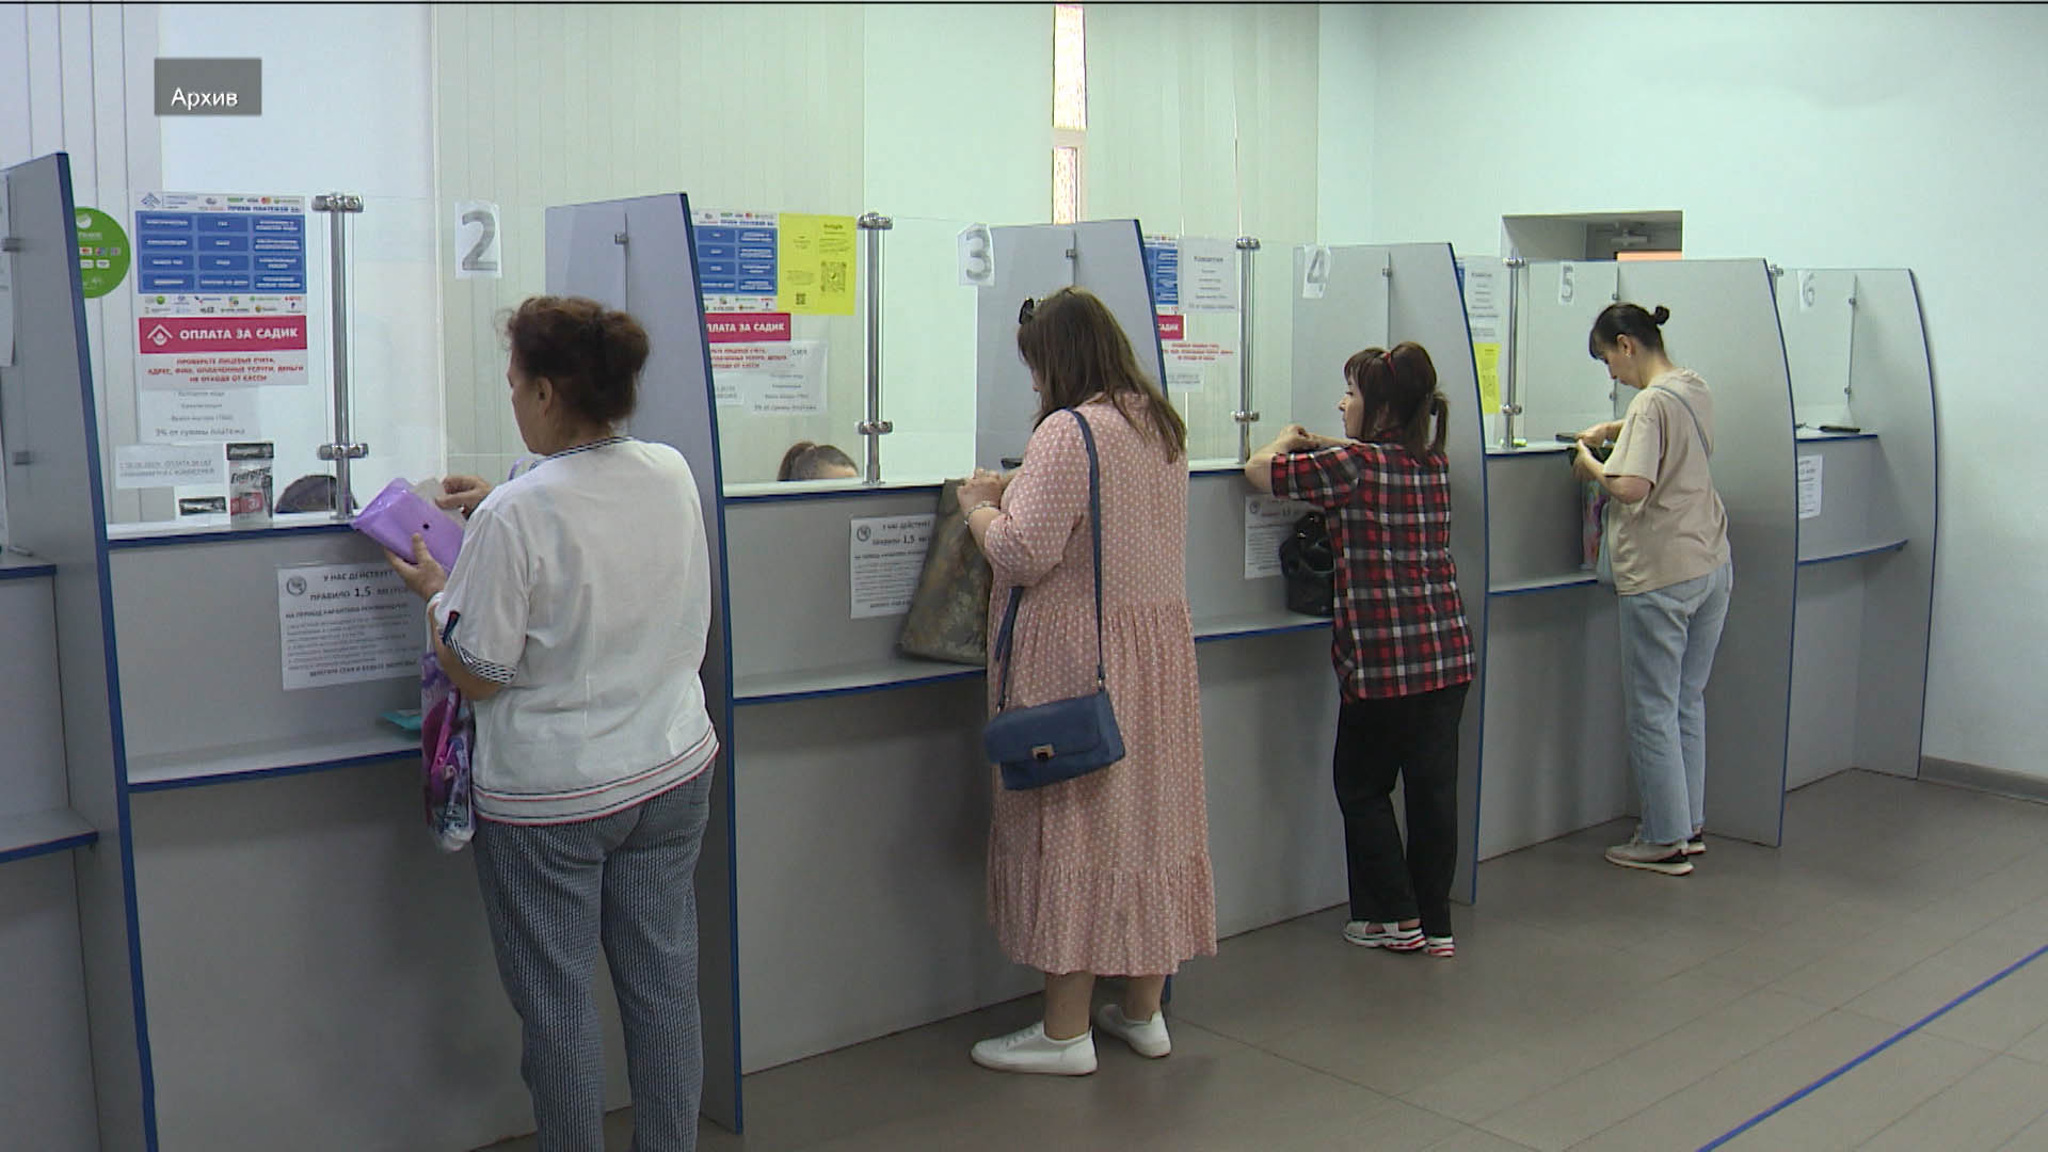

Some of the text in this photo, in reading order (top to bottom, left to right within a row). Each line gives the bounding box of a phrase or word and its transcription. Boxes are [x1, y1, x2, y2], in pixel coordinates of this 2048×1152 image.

[462, 210, 497, 271] 2
[966, 229, 991, 281] 3
[1307, 249, 1327, 292] 4
[1561, 265, 1574, 303] 5
[1802, 272, 1816, 308] 6
[179, 327, 299, 341] ОПЛАТА ЗА САДИК
[739, 323, 751, 332] ЗА
[754, 322, 785, 331] САДИК
[310, 591, 350, 601] ПРАВИЛО
